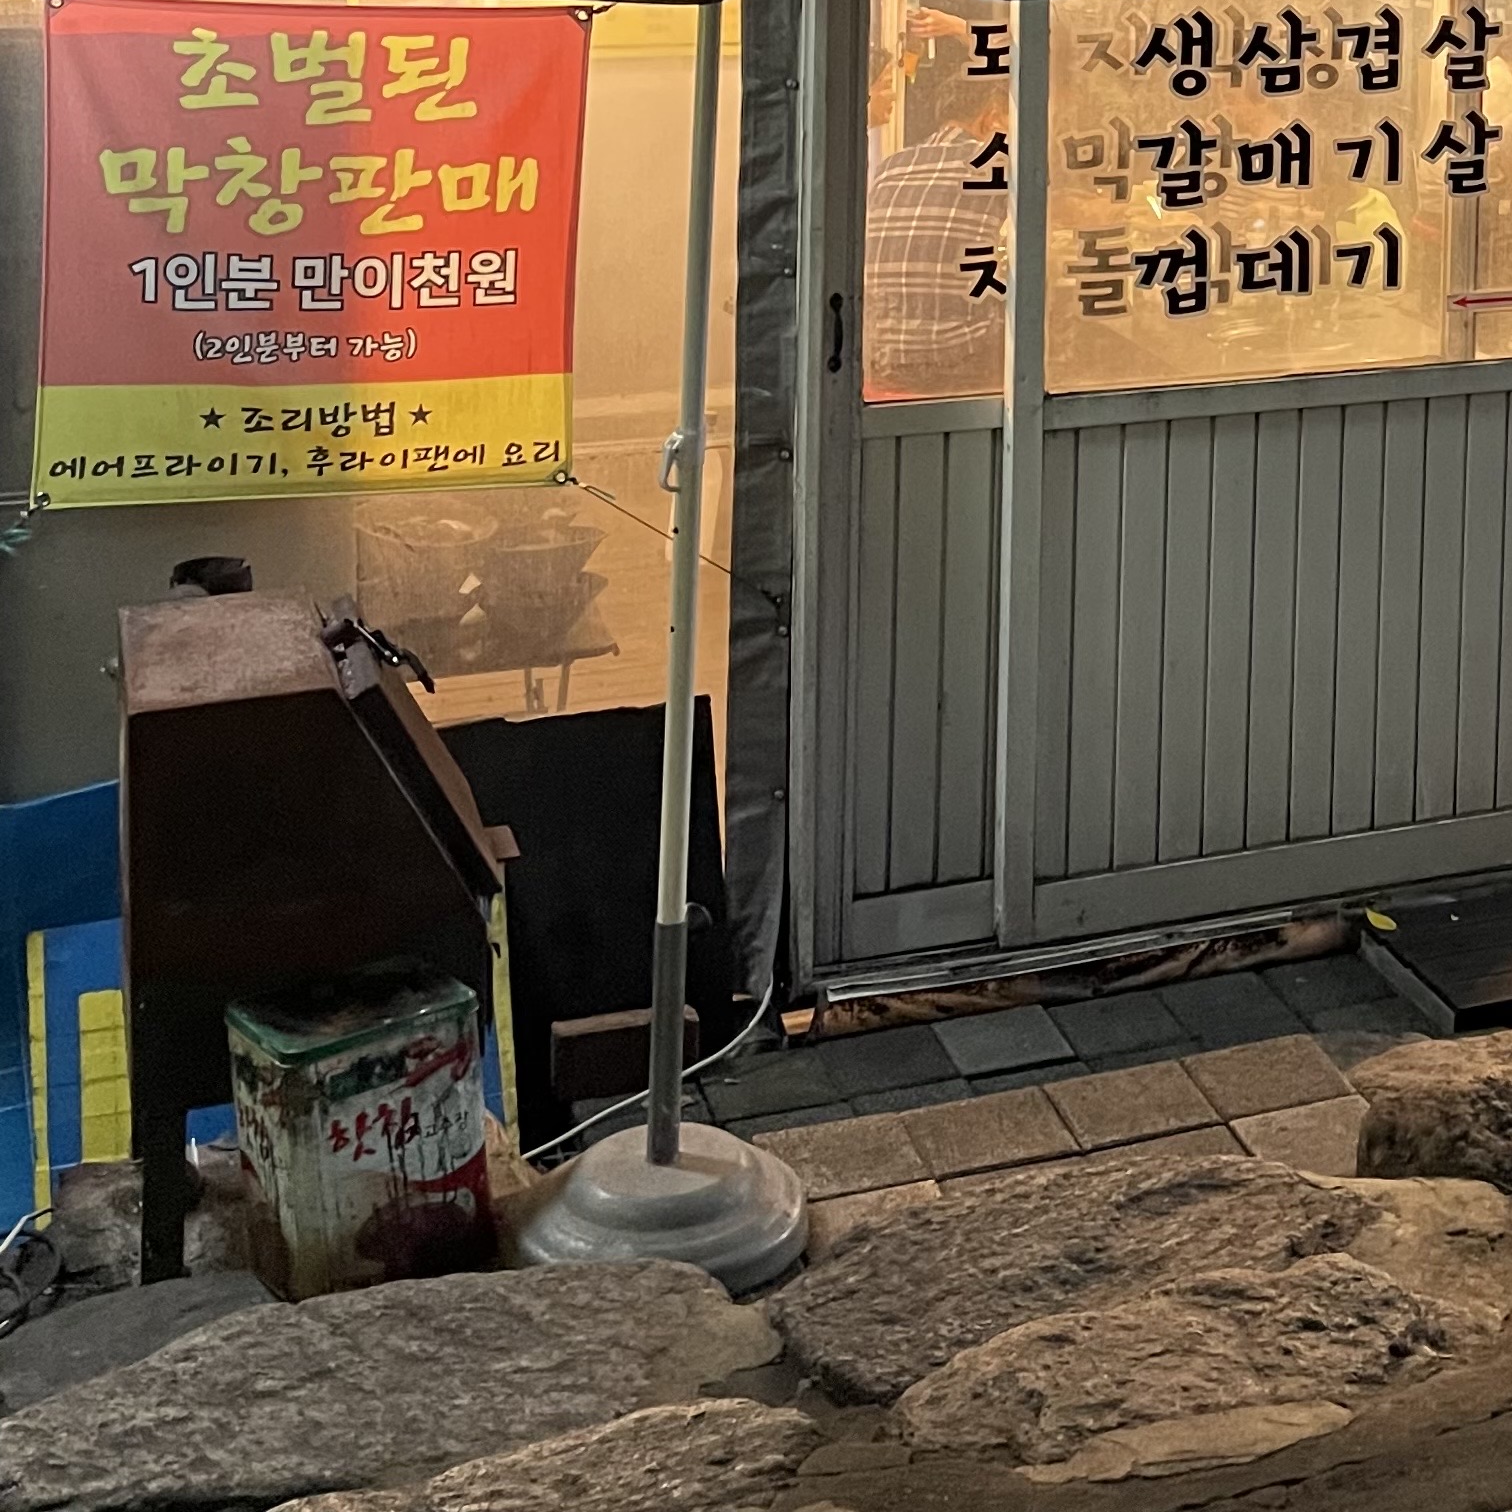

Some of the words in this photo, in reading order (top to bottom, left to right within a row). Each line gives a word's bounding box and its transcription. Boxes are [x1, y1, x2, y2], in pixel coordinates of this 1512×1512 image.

[172, 27, 478, 125] 초벌된
[1135, 5, 1501, 97] 생삼겹살
[100, 137, 539, 235] 막창판매
[1137, 109, 1501, 210] 갈매기살
[130, 251, 277, 311] 1인분
[292, 248, 519, 311] 만이천원
[1134, 224, 1401, 316] 껍데기
[193, 332, 338, 364] (2인분부터
[348, 329, 417, 360] 가능)
[49, 452, 289, 480] 에어프라이기,
[306, 444, 486, 476] 후라이팬에
[501, 440, 561, 467] 요리
[242, 401, 397, 437] 조리방법
